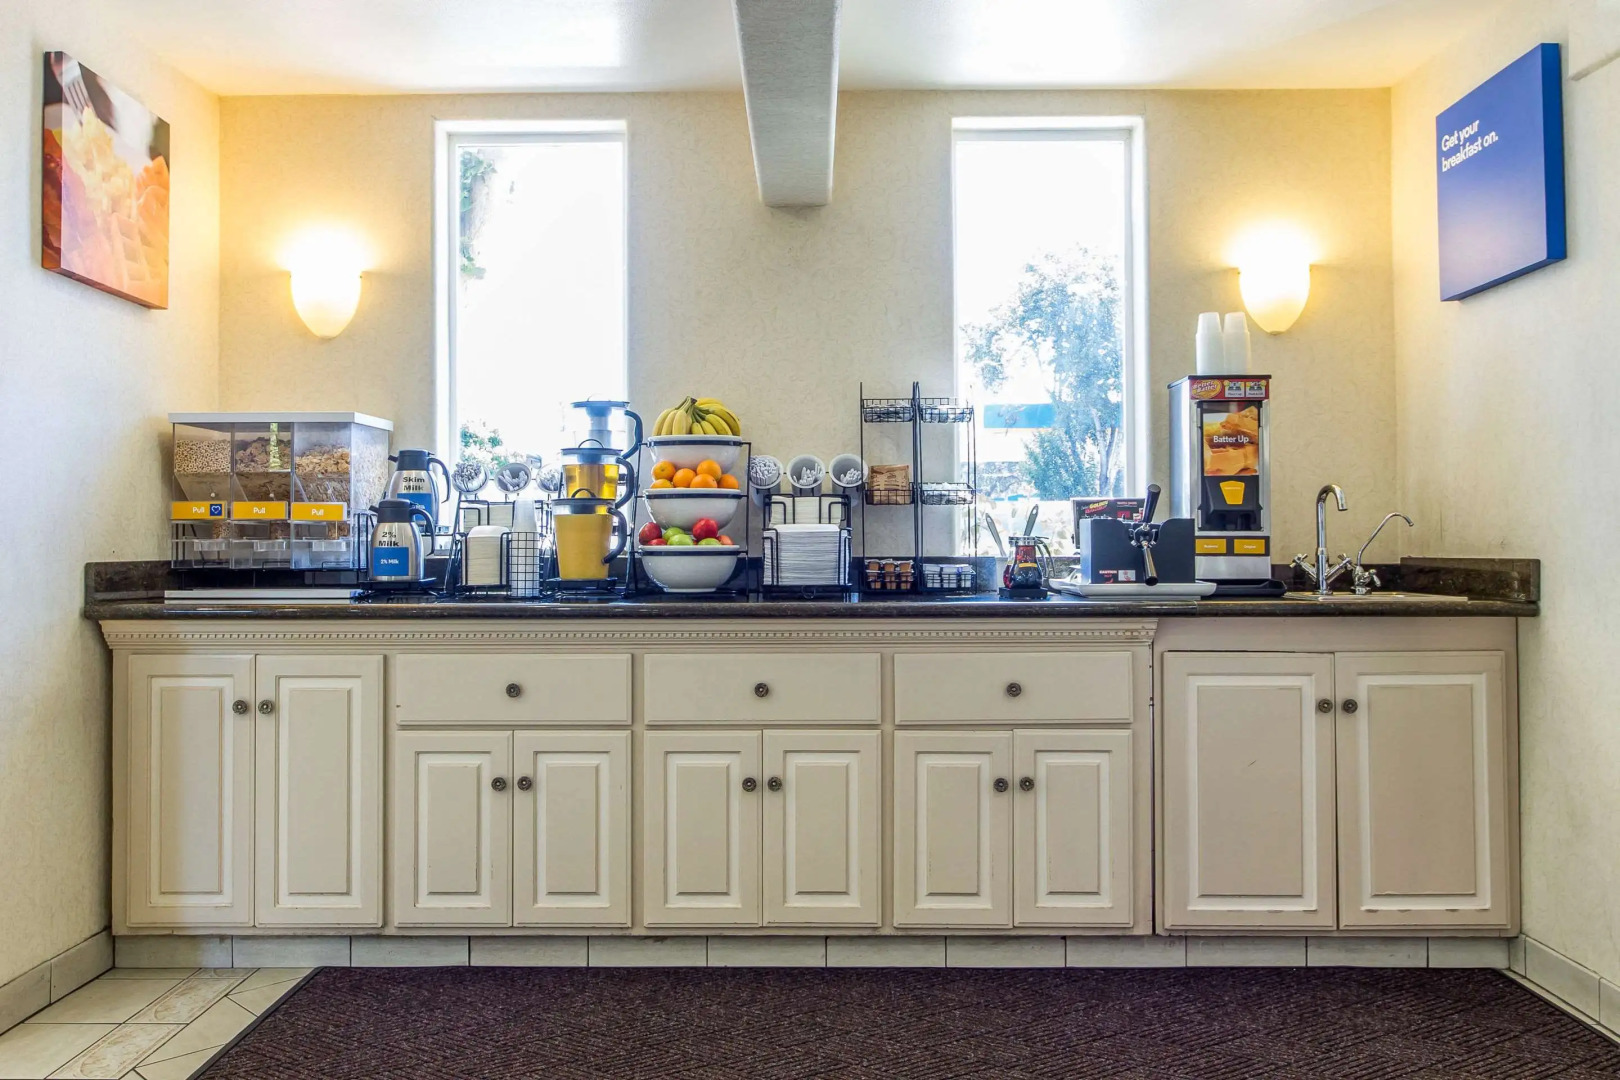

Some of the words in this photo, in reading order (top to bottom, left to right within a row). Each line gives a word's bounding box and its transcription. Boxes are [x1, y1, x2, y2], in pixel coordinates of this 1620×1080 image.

[1441, 130, 1459, 151] Get
[1459, 120, 1479, 145] your
[1442, 136, 1482, 172] breakfast
[1483, 131, 1499, 147] on.
[1213, 435, 1236, 443] Batter
[1237, 435, 1249, 444] Up
[253, 506, 266, 514] Pull
[311, 508, 324, 516] Pull
